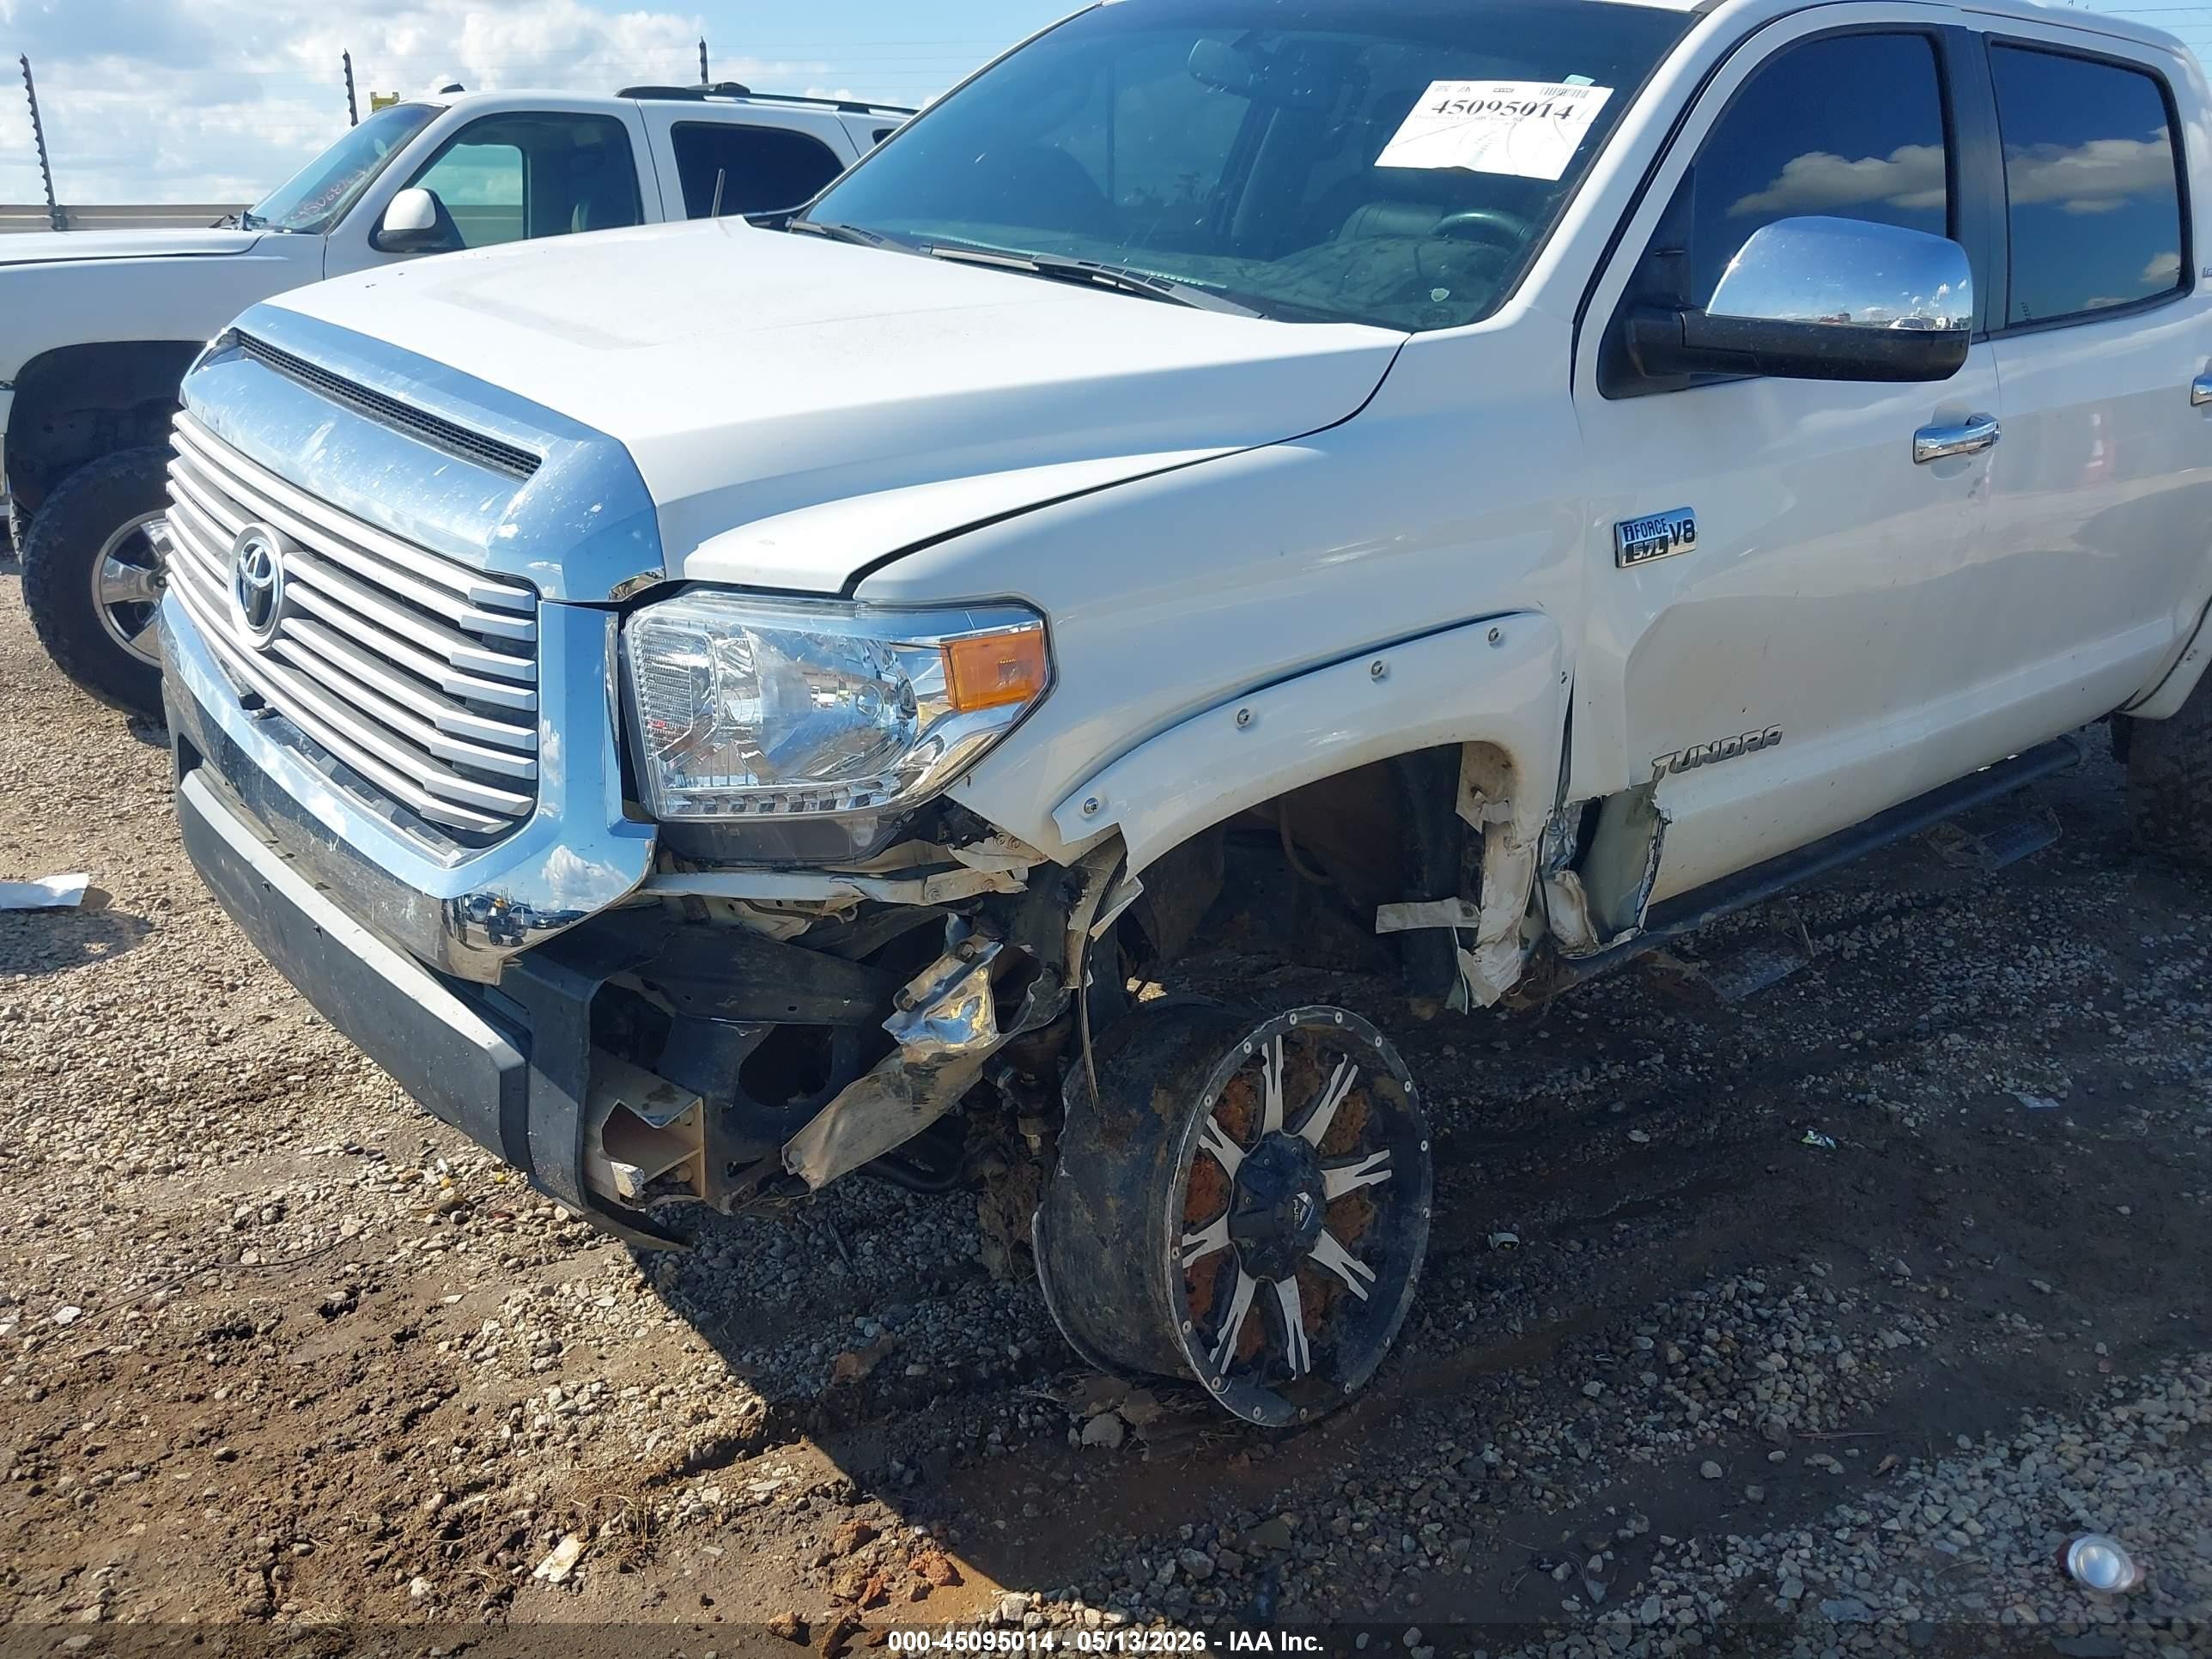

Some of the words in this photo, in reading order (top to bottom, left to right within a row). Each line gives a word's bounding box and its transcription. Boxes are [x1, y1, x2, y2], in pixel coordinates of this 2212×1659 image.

[1431, 98, 1575, 120] 45095014
[1668, 518, 1696, 546] V8
[1650, 723, 1784, 781] TUNDRA
